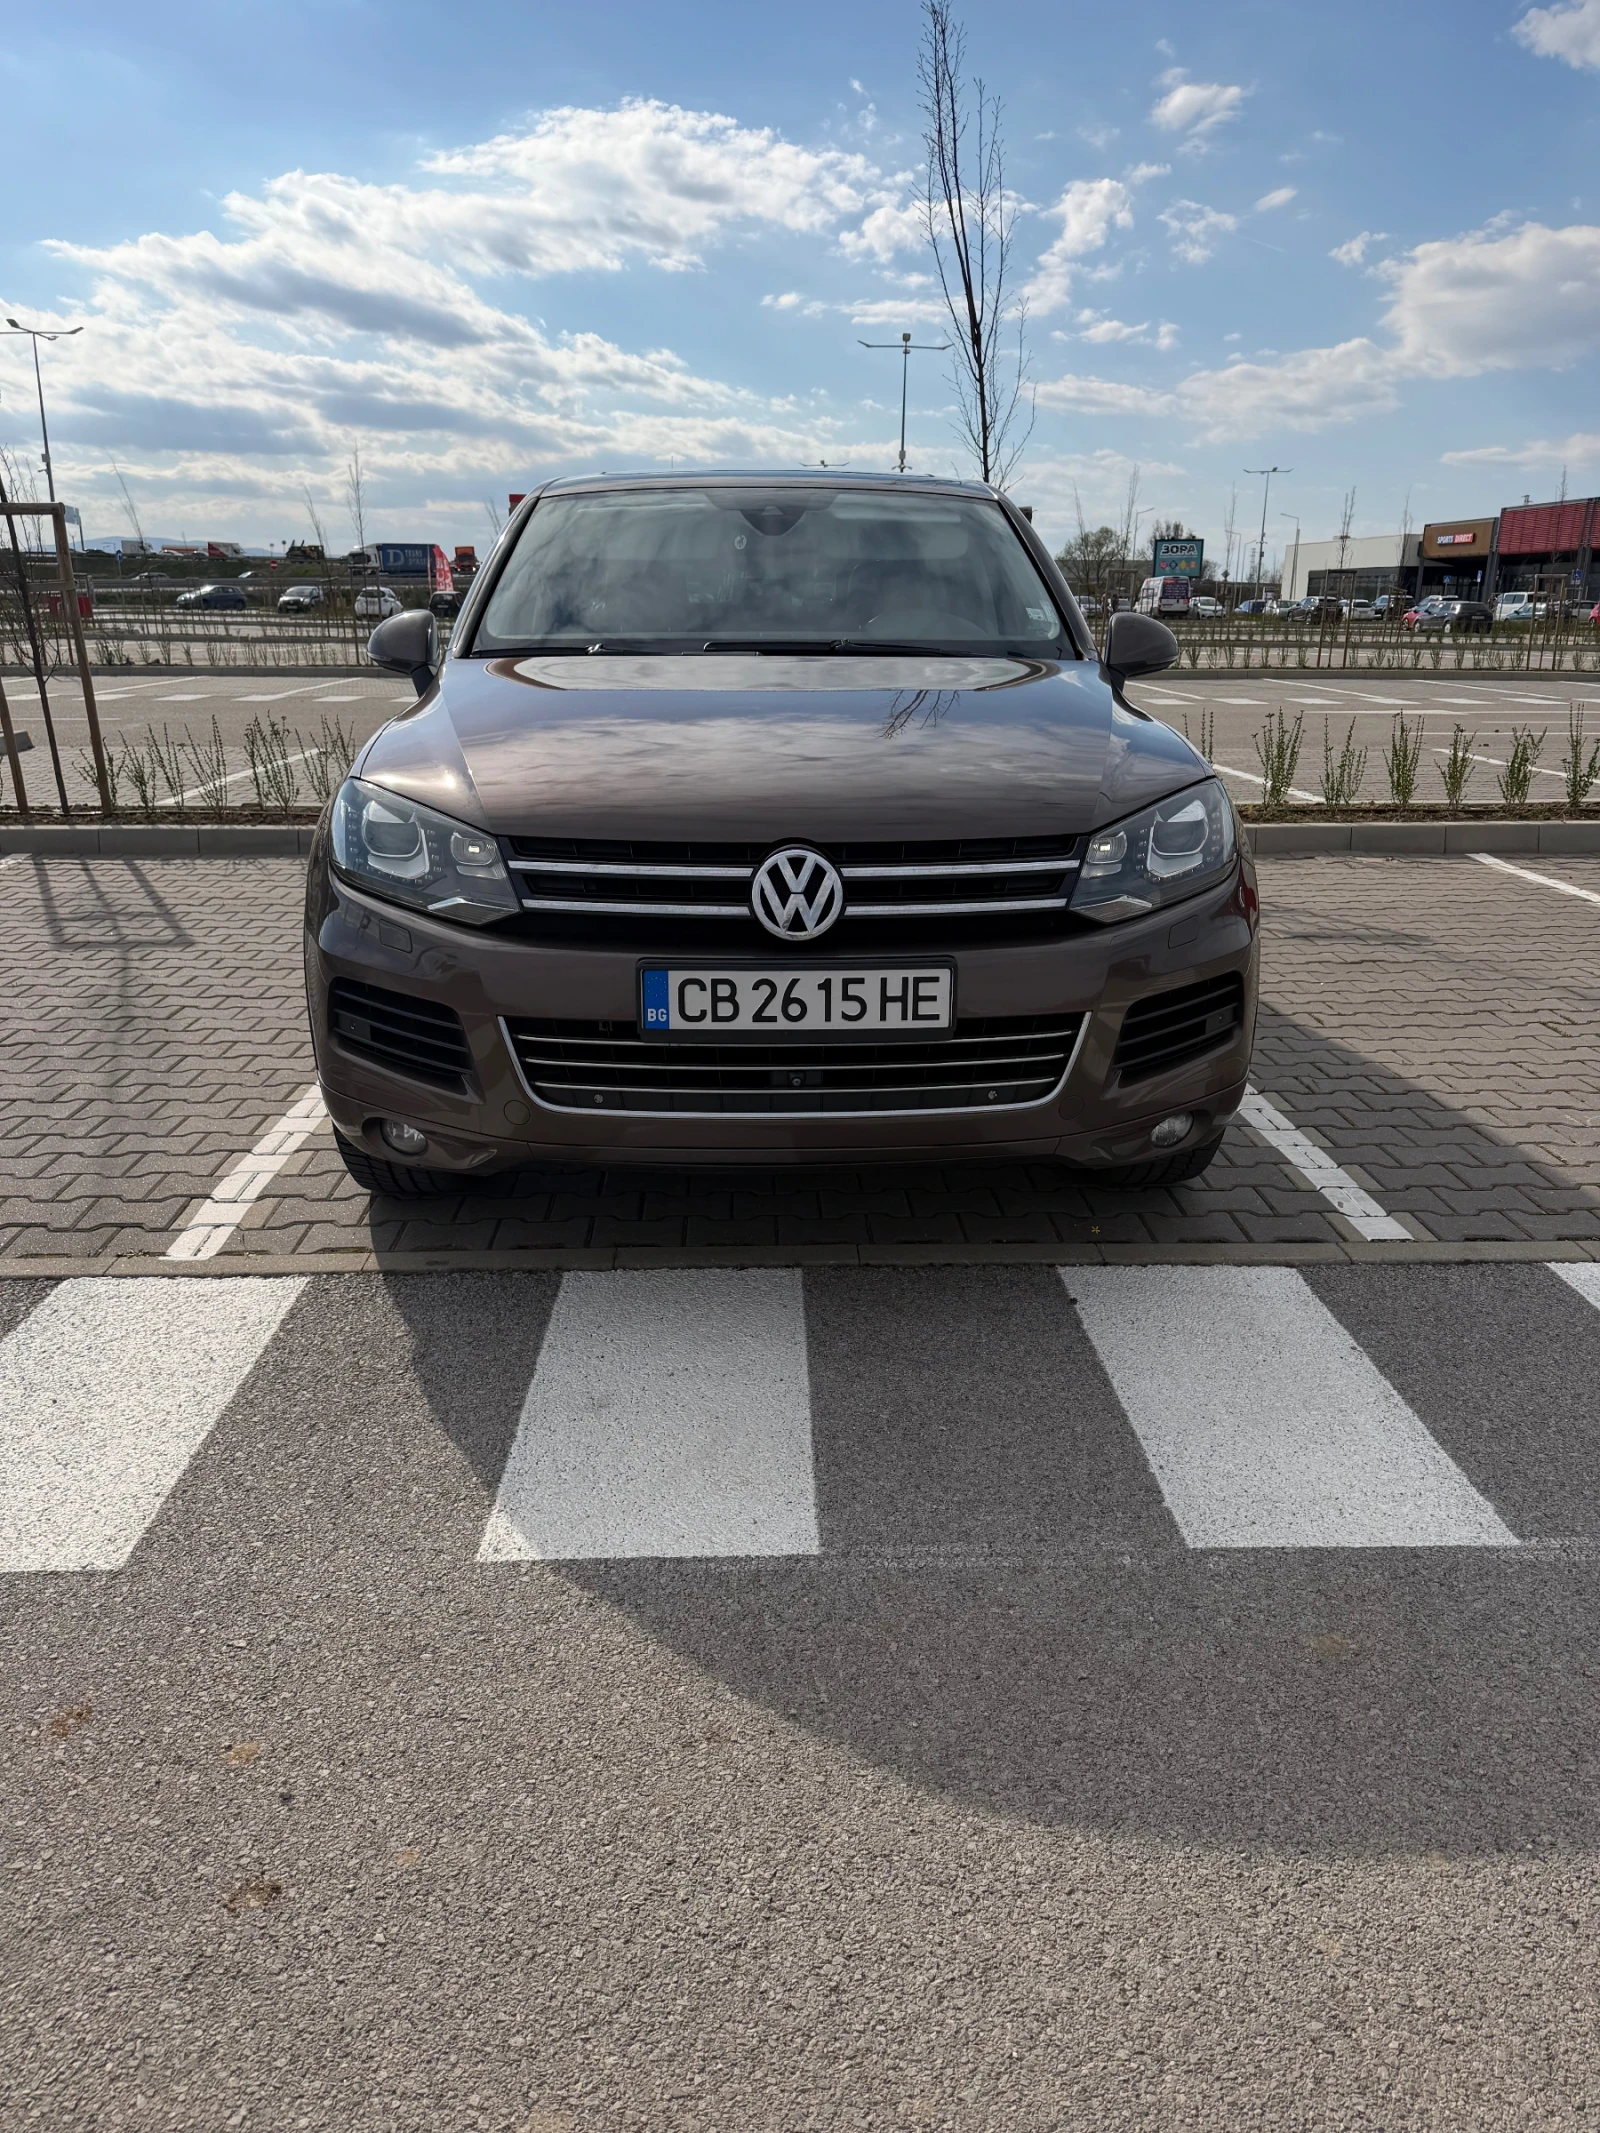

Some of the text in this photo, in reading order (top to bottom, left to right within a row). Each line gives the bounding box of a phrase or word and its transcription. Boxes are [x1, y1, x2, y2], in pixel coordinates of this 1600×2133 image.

[1437, 533, 1473, 544] SPORTS DIRECT
[1160, 544, 1198, 555] ЗОРА
[752, 849, 843, 940] VW
[677, 976, 941, 1023] CB 2615 HE
[647, 1008, 667, 1022] BG
